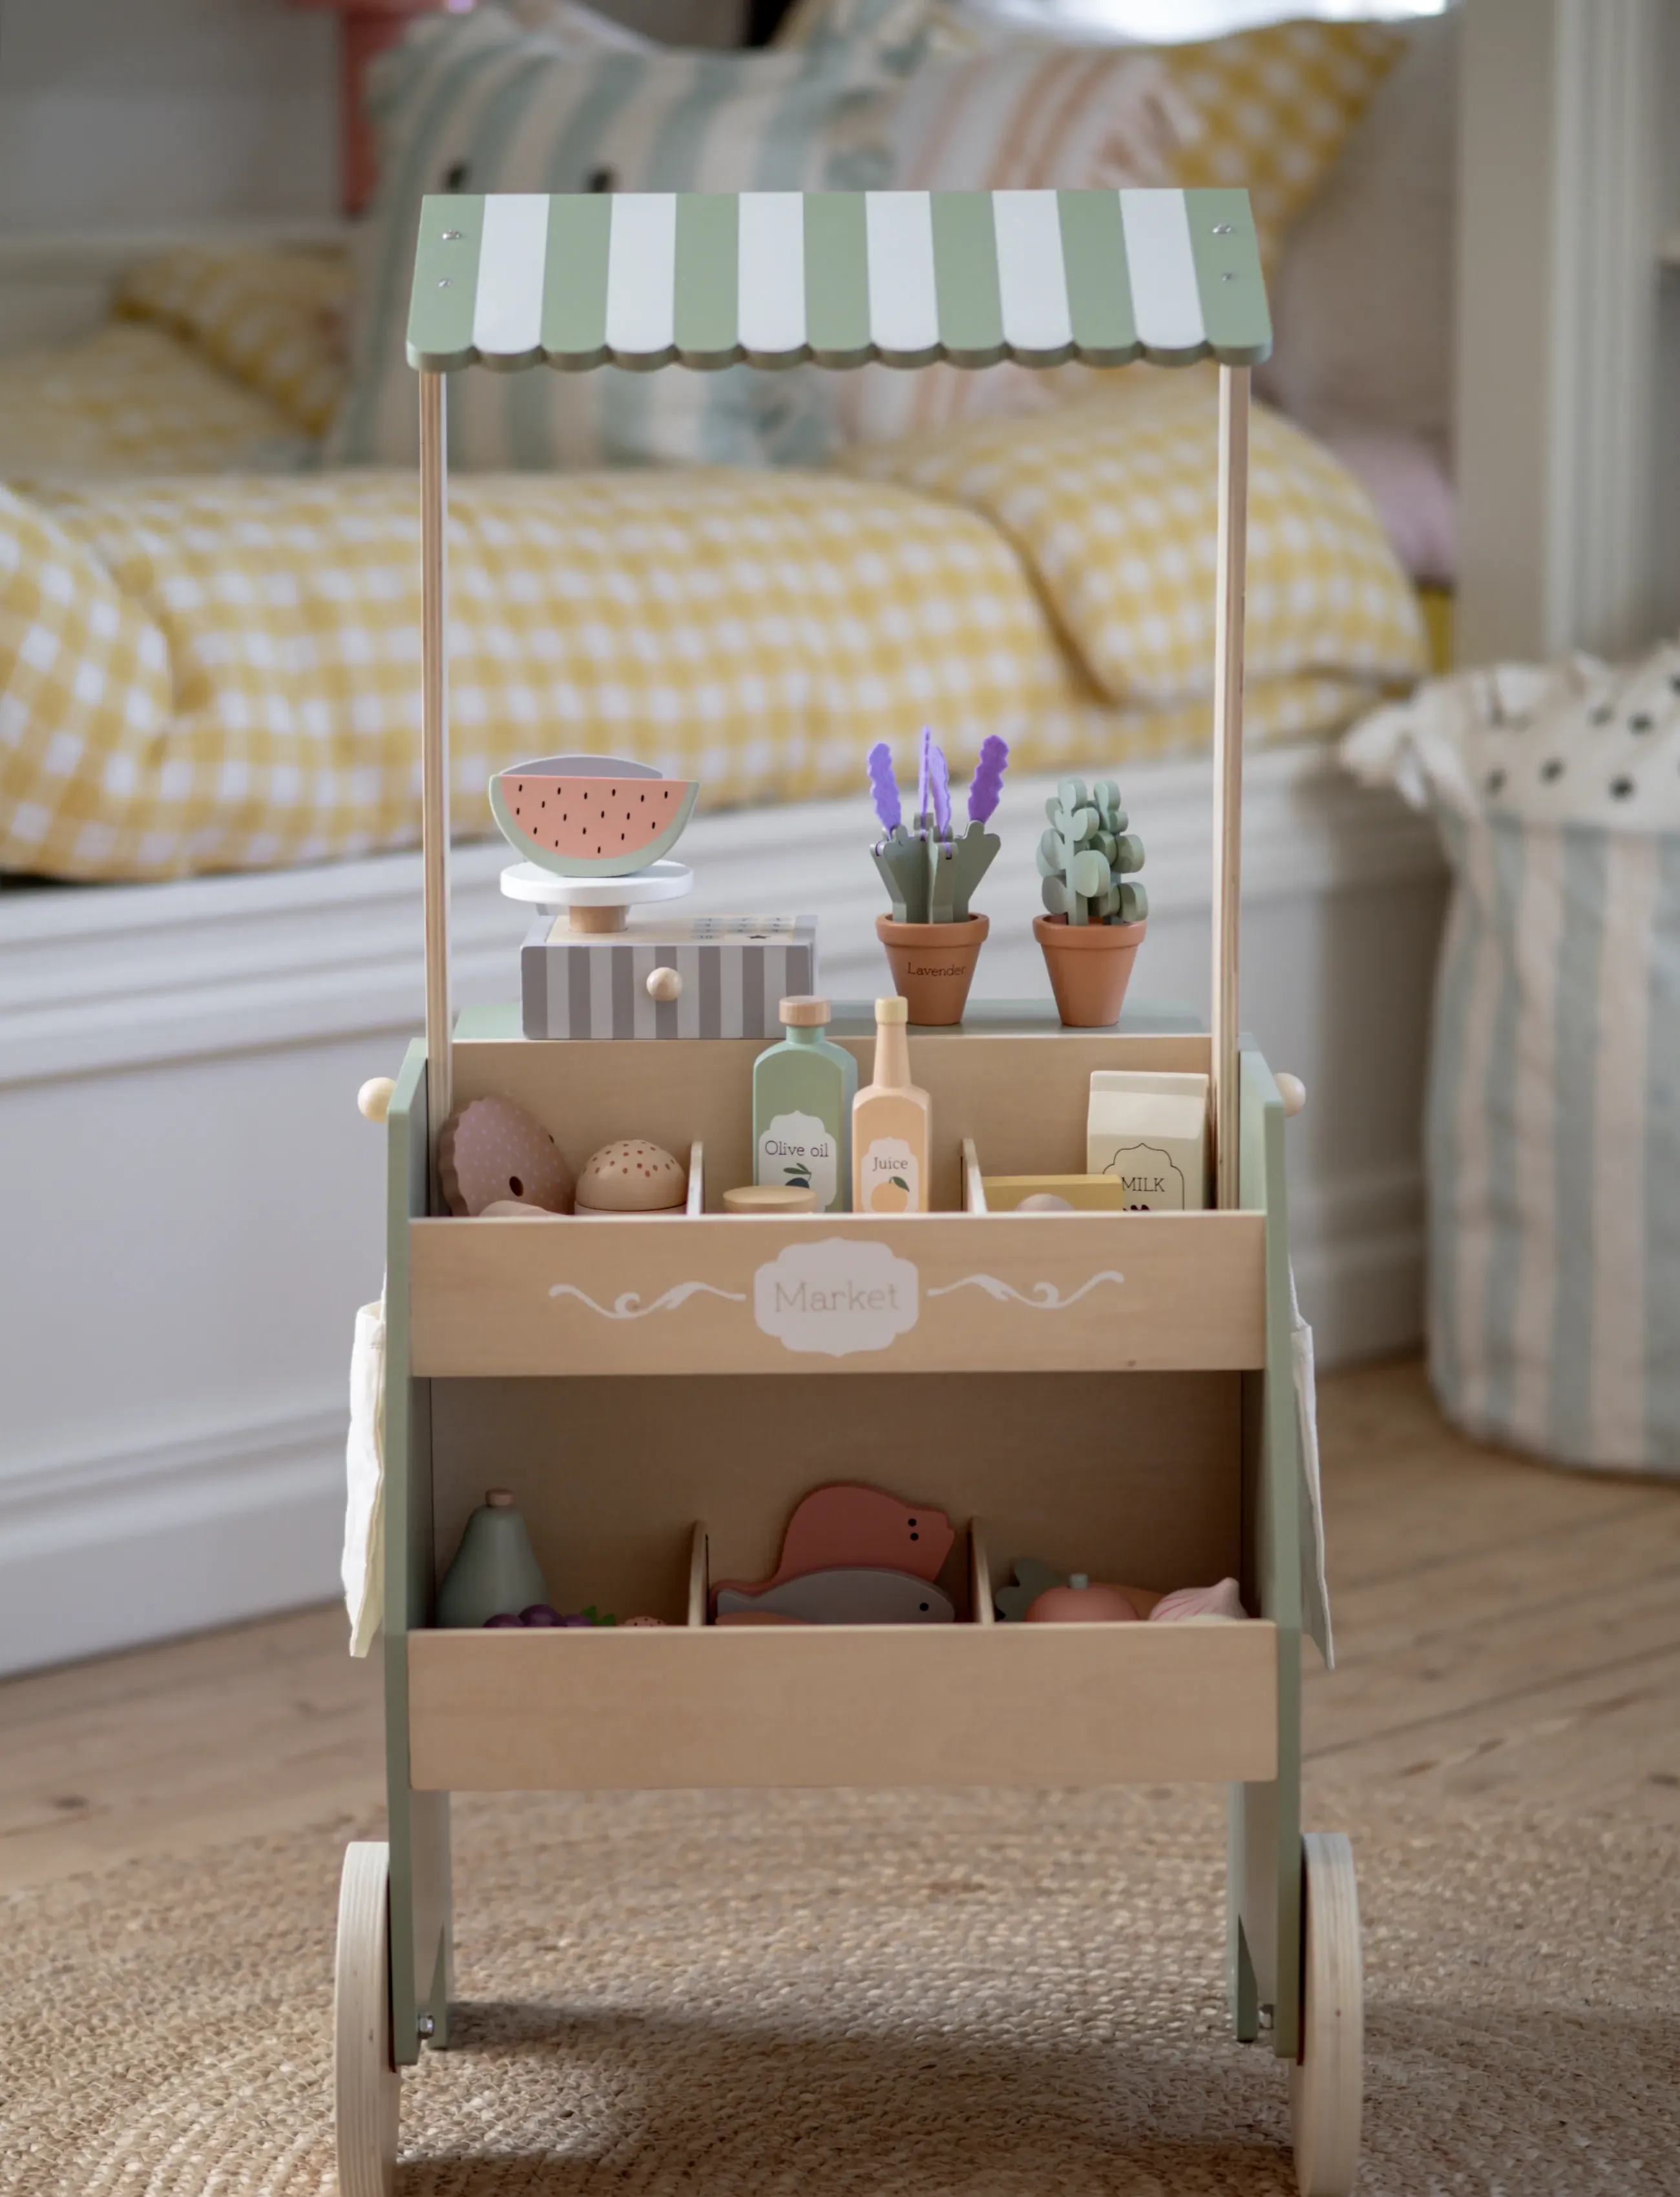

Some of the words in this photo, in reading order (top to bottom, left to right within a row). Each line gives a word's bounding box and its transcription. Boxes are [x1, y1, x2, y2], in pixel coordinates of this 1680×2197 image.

[907, 962, 967, 976] Lavender
[765, 1141, 804, 1156] Olive
[810, 1143, 829, 1157] oil
[872, 1157, 908, 1172] Juice
[1122, 1177, 1165, 1192] MILK
[775, 1280, 899, 1313] Market
